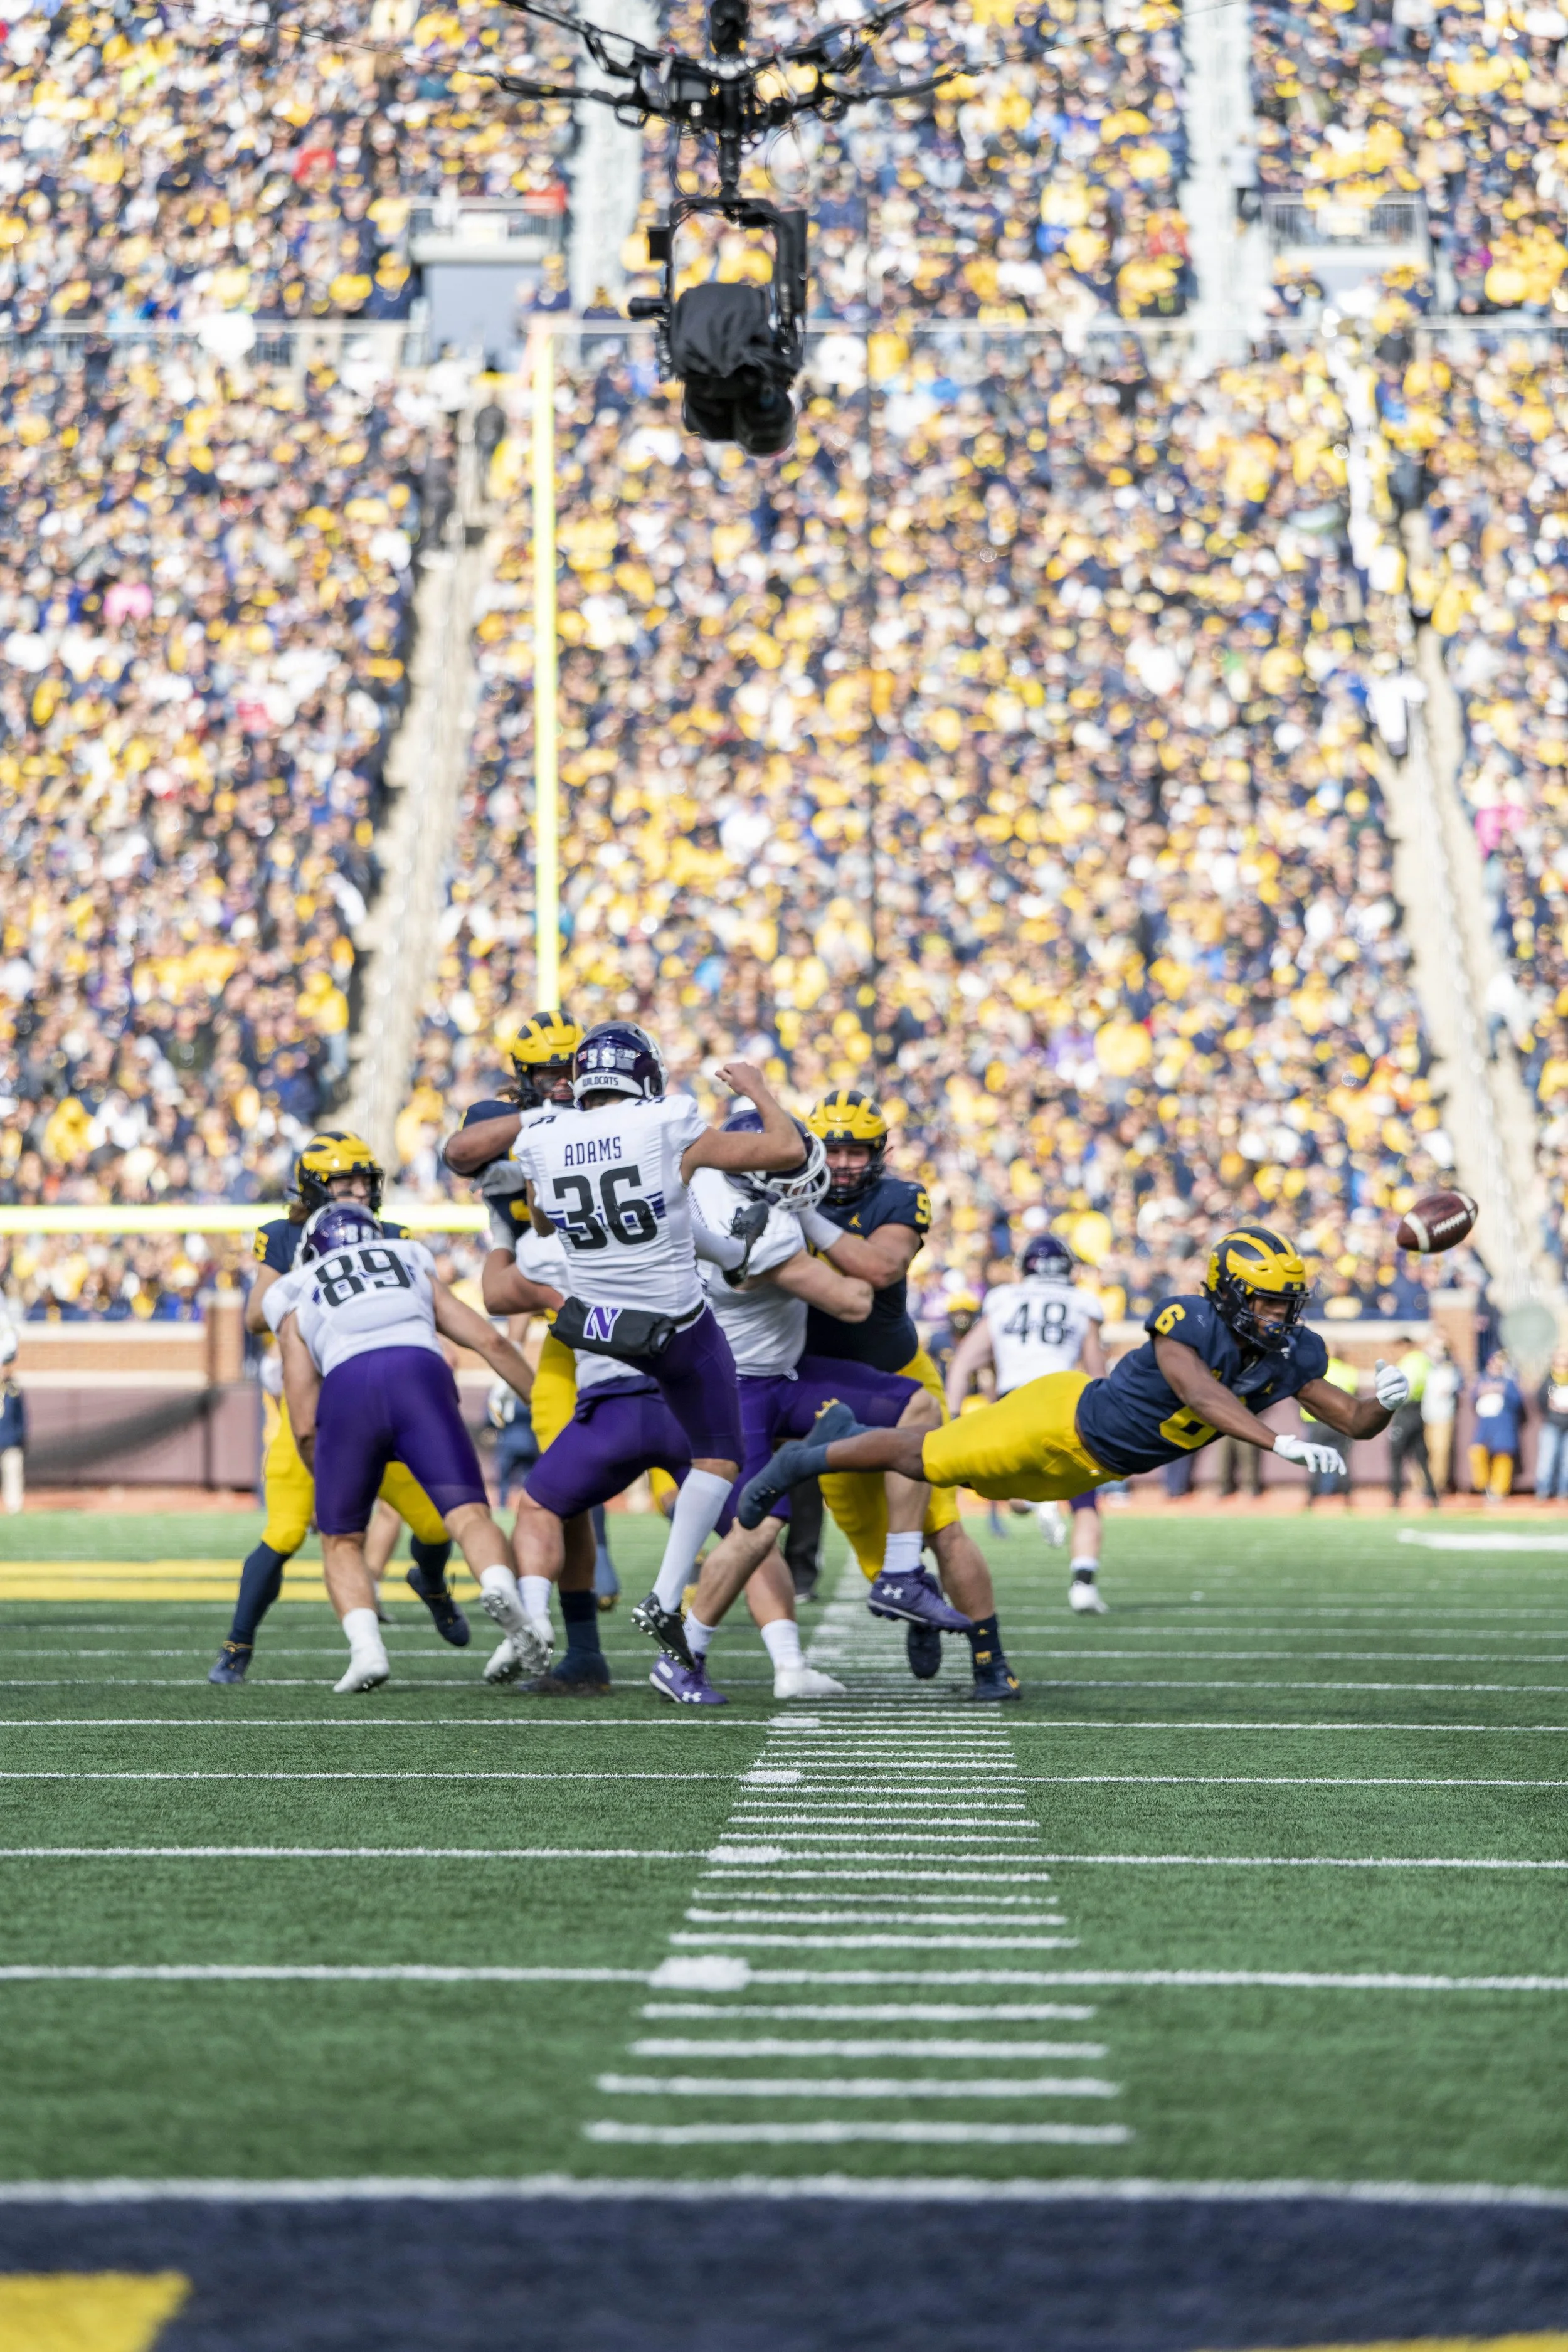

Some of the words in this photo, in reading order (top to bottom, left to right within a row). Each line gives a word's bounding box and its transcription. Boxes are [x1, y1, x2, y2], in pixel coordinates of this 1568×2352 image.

[586, 1048, 616, 1069] 36
[582, 1076, 618, 1087] WILDCATS
[565, 1136, 621, 1167] ADAMS
[553, 1165, 657, 1249] 36
[315, 1249, 410, 1306] 89
[583, 1306, 623, 1342] N
[1003, 1303, 1066, 1343] 48
[1155, 1304, 1185, 1335] 6
